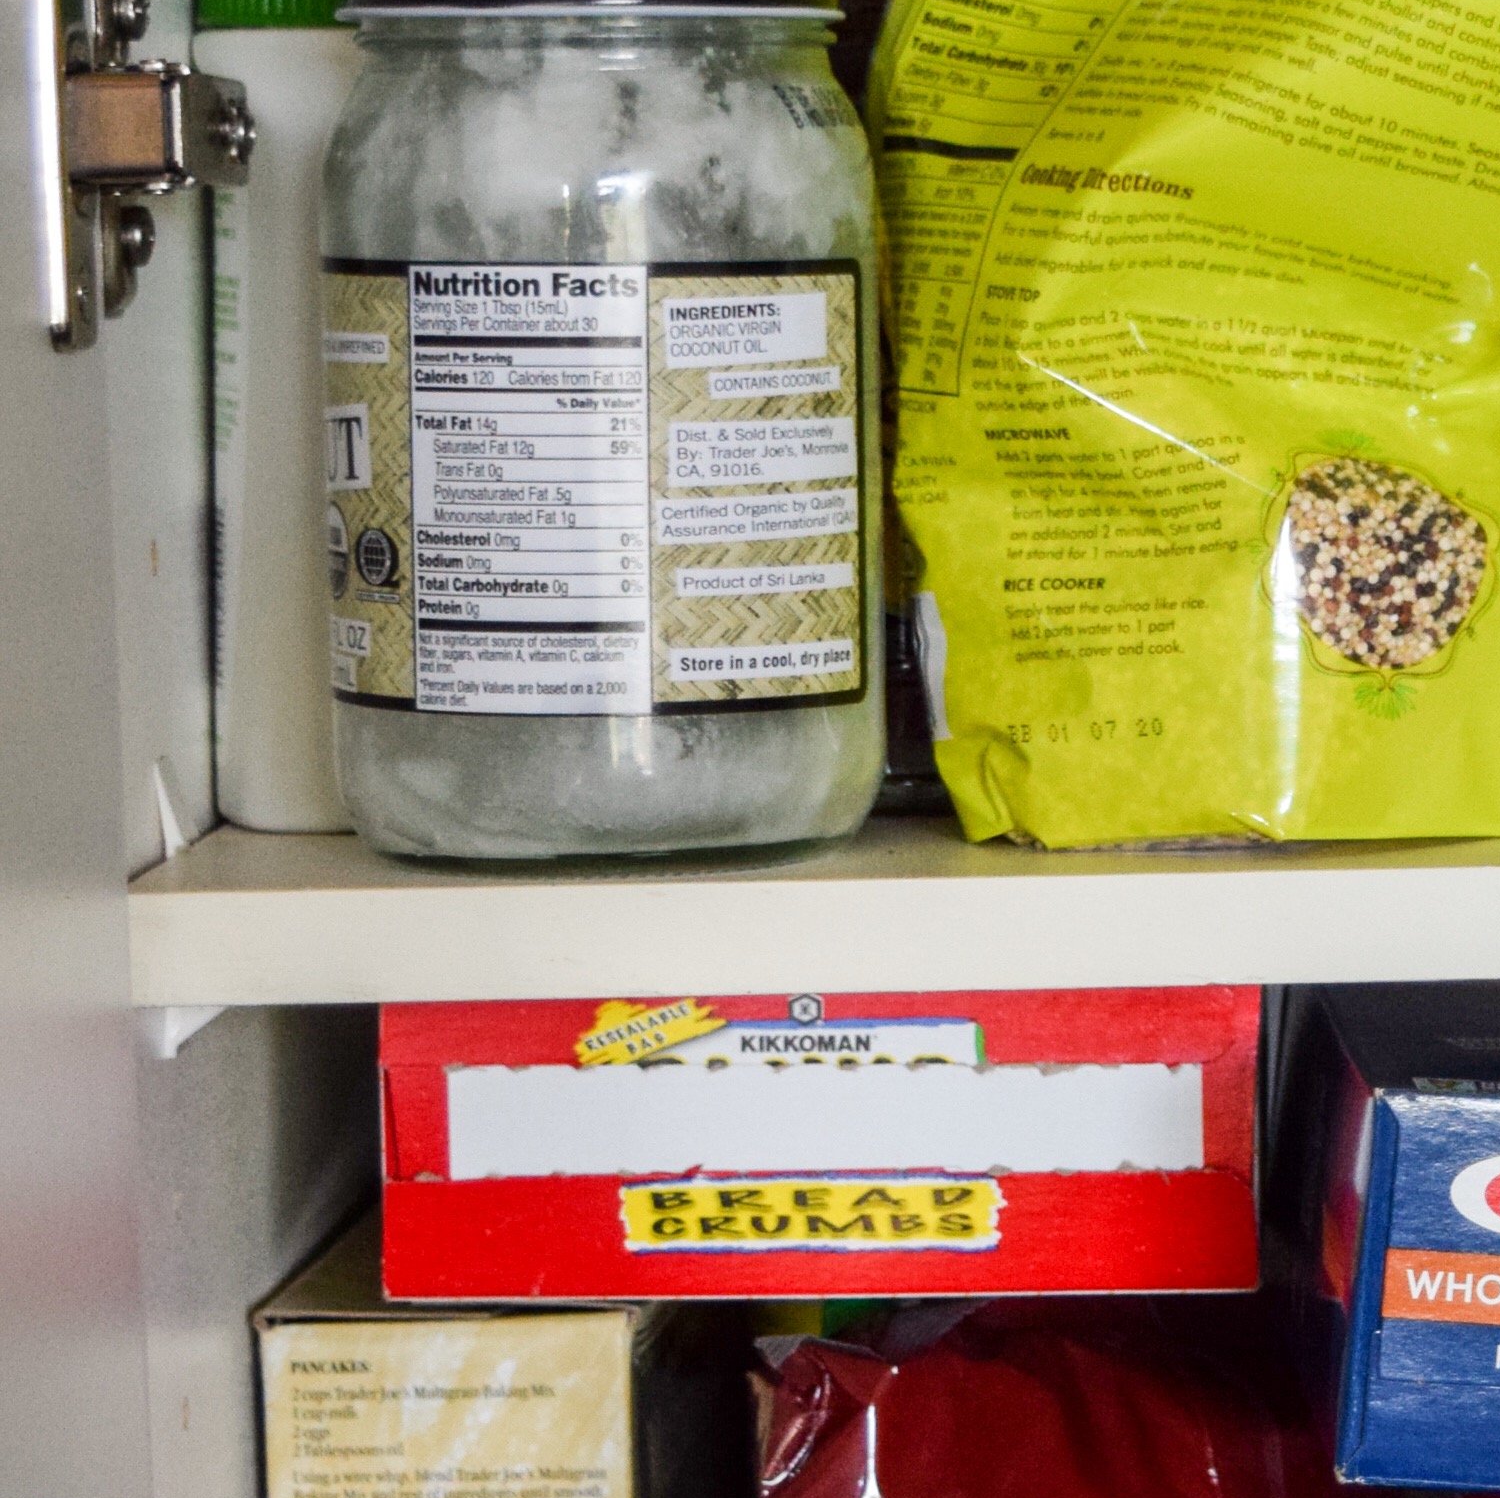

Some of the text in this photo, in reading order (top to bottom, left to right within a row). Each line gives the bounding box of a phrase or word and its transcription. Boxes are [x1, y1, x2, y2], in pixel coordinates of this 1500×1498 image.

[1082, 167, 1194, 200] Directions
[414, 271, 638, 298] Nutrition Facts
[670, 303, 781, 321] INGREDIENTS:
[670, 320, 782, 339] ORGANIC VIRGIN
[414, 369, 641, 387] Calories 120 Calories from Fat 120
[415, 414, 498, 435] Total Fat 14g
[985, 429, 1071, 441] MICROWAVE
[683, 571, 825, 590] Product of Sri Lanka
[1003, 578, 1106, 592] RICE COOKER
[1050, 723, 1068, 743] 01
[1090, 720, 1116, 740] 07
[1136, 718, 1164, 737] 20
[741, 1034, 872, 1053] KIKKOMAN
[651, 1187, 973, 1210] BREAD
[652, 1213, 974, 1239] CRUMBS
